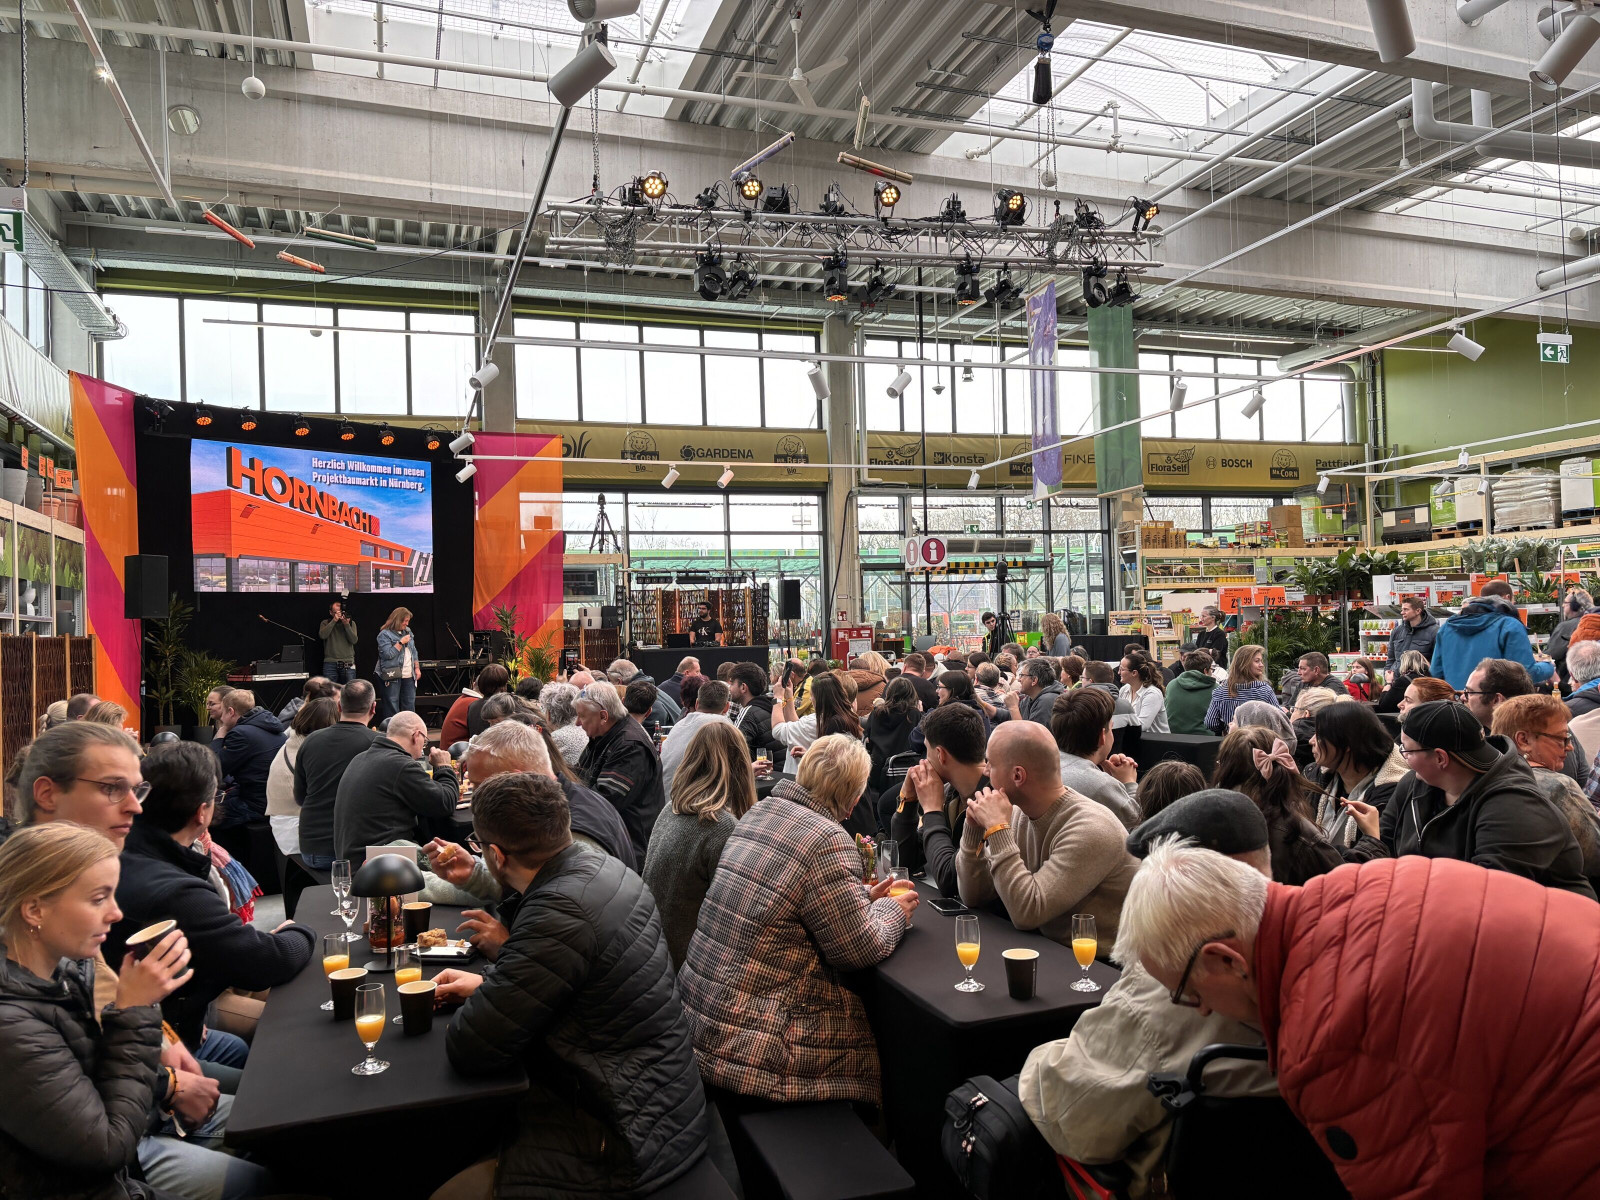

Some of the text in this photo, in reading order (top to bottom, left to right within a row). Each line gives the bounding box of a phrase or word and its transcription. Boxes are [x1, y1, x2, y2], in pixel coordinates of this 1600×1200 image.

[696, 448, 754, 459] GARDENA
[945, 453, 985, 464] Konsta
[1064, 454, 1096, 464] FINE
[312, 457, 425, 477] Herzlich Willkommen im neuen
[1150, 463, 1188, 473] FloraSelf
[1221, 458, 1253, 468] BOSCH
[1315, 459, 1359, 468] Pattfield
[312, 472, 426, 492] Projektbaumarkt in Nürnberg.
[226, 446, 370, 534] HORNBACH
